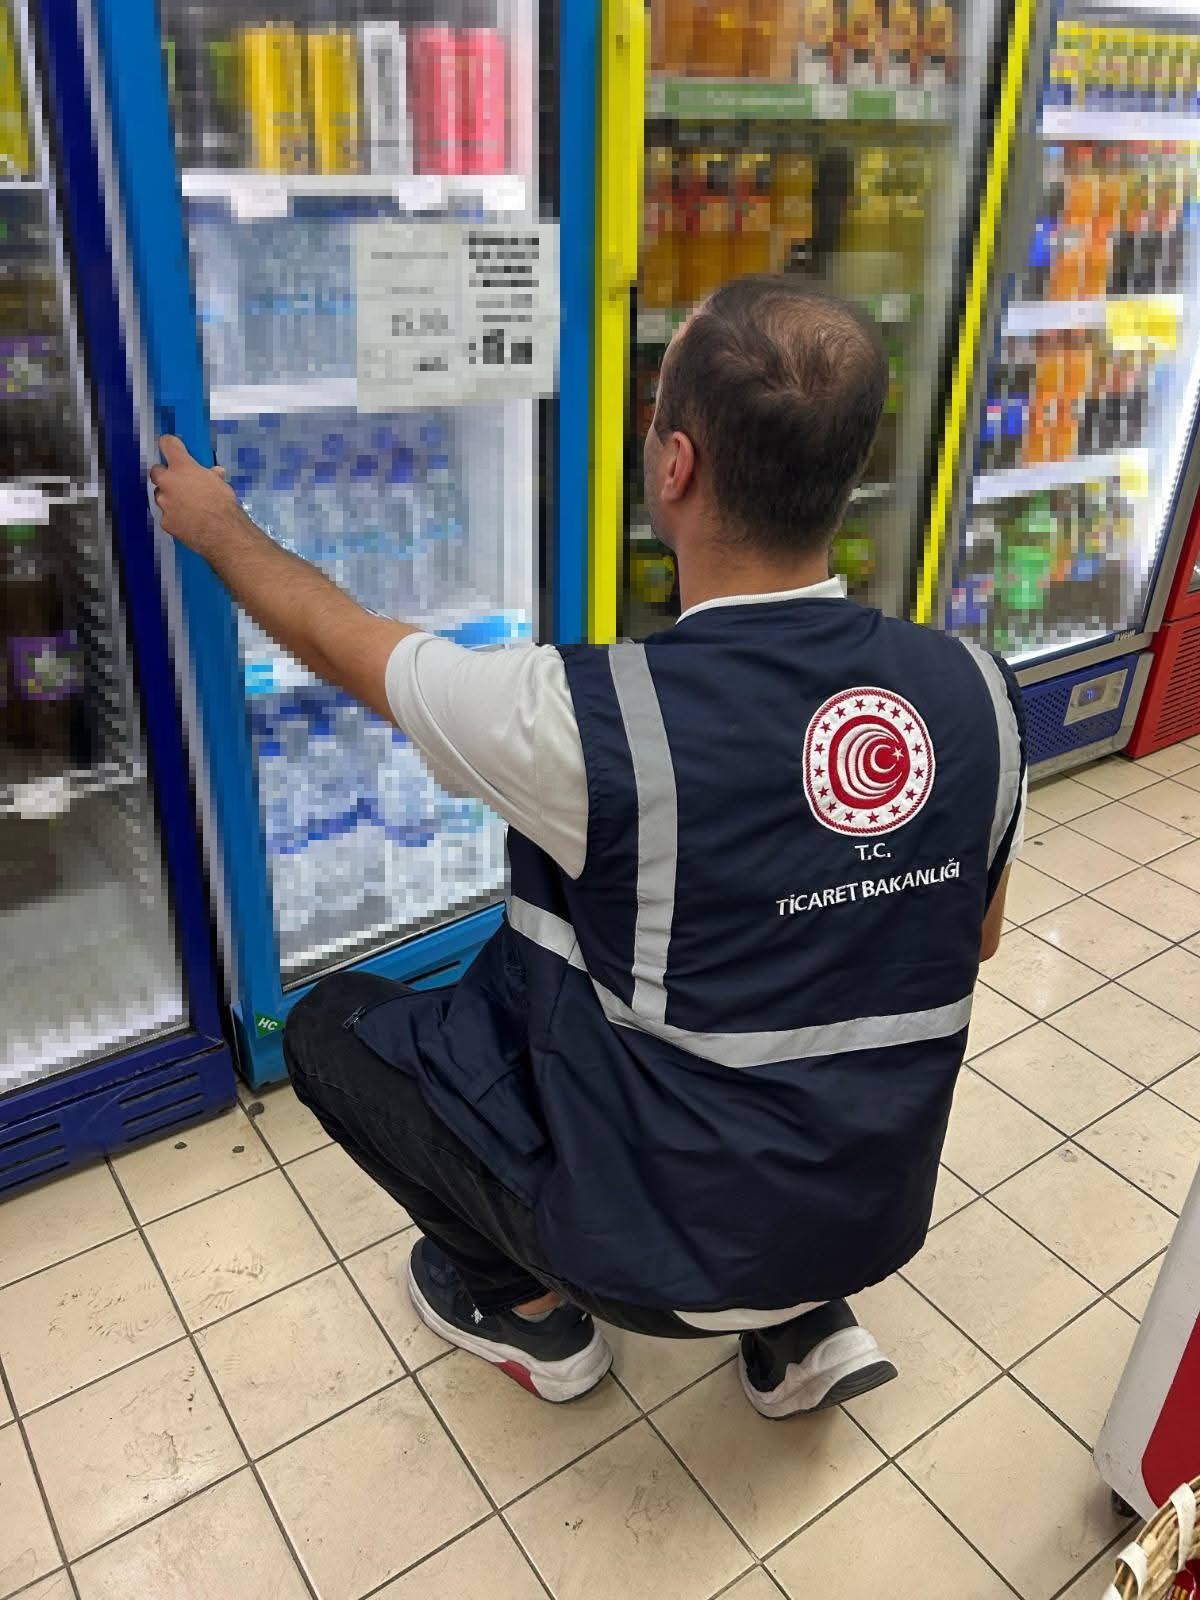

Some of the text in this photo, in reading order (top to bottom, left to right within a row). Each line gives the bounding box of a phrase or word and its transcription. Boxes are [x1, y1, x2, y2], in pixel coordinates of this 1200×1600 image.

[855, 842, 891, 861] T.C.
[776, 858, 960, 916] TİCARET BAKANLIĞI
[257, 1017, 278, 1030] HC
